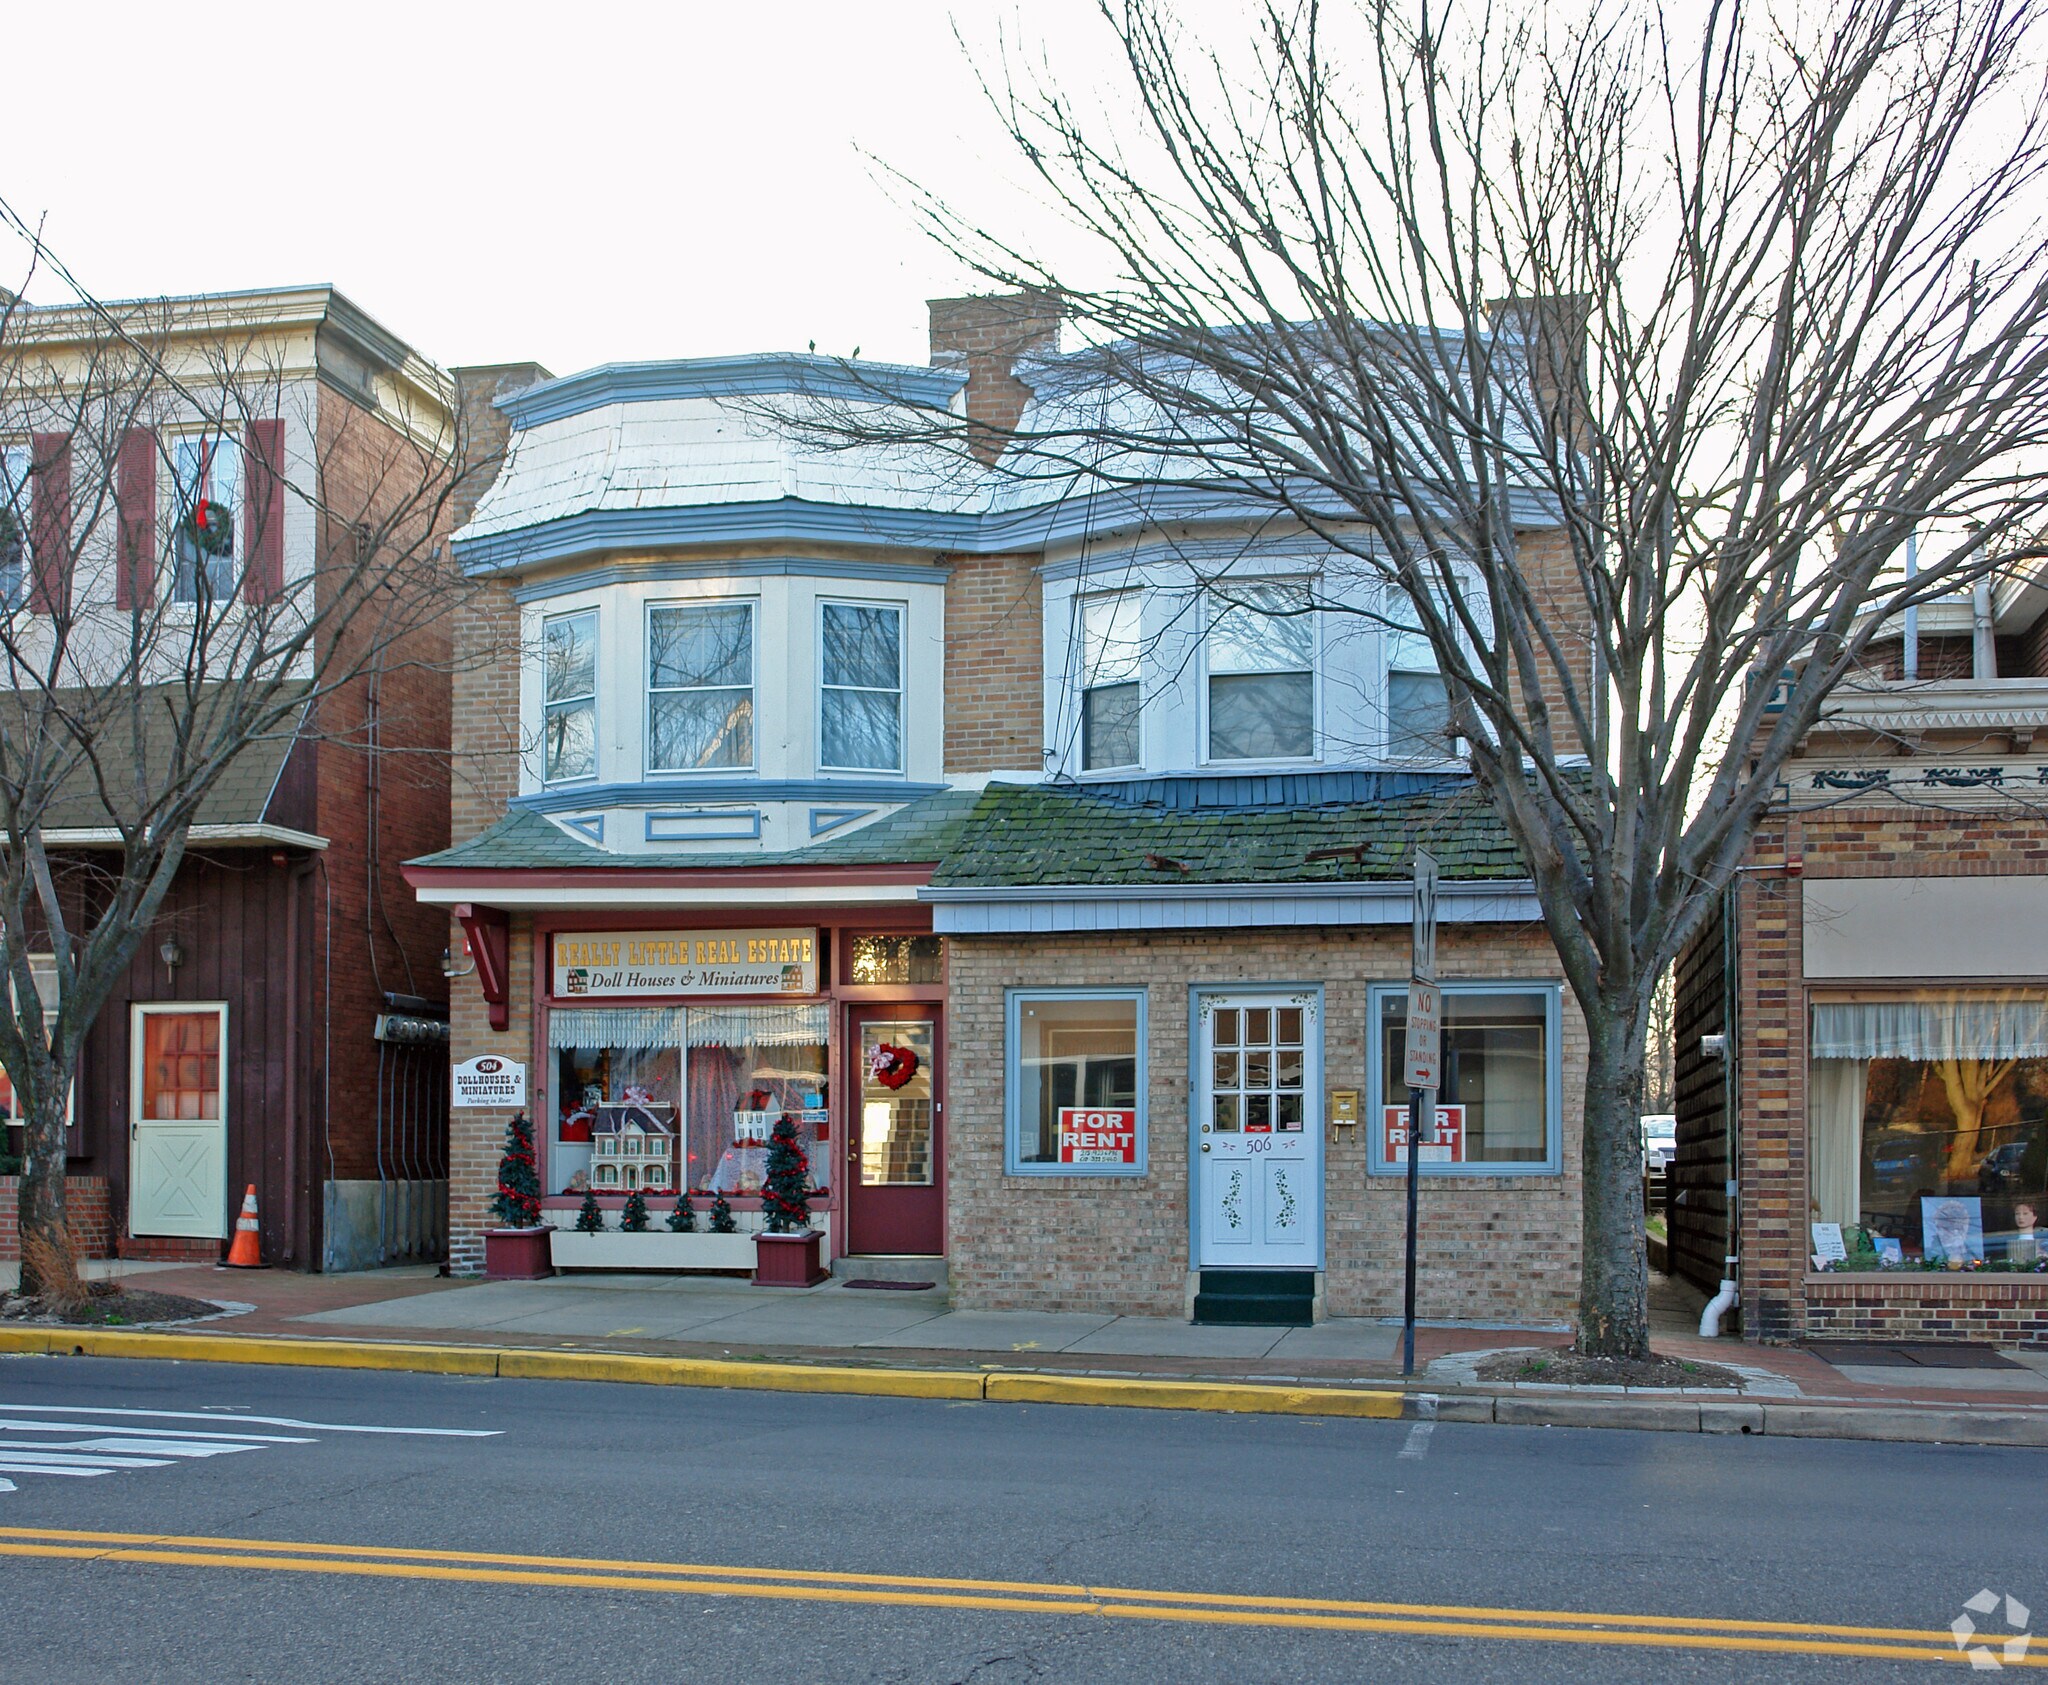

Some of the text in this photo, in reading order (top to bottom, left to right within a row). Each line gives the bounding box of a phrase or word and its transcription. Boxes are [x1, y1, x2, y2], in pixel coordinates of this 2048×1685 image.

[557, 938, 812, 967] REALLY LITTLE REAL ESTATE
[591, 970, 780, 988] Doll Houses & Miniatures
[1418, 993, 1431, 1013] NO
[1411, 1016, 1437, 1033] STOPPING
[1419, 1035, 1427, 1047] OR
[1409, 1050, 1437, 1065] STANDING
[480, 1061, 498, 1072] 504
[457, 1075, 521, 1085] DOLLHOUSES &
[461, 1086, 515, 1095] MINIATURES
[467, 1097, 489, 1105] Parking
[1072, 1113, 1124, 1129] FOR
[1397, 1111, 1449, 1126] FR
[1063, 1132, 1134, 1148] RENT
[1246, 1136, 1271, 1154] 506
